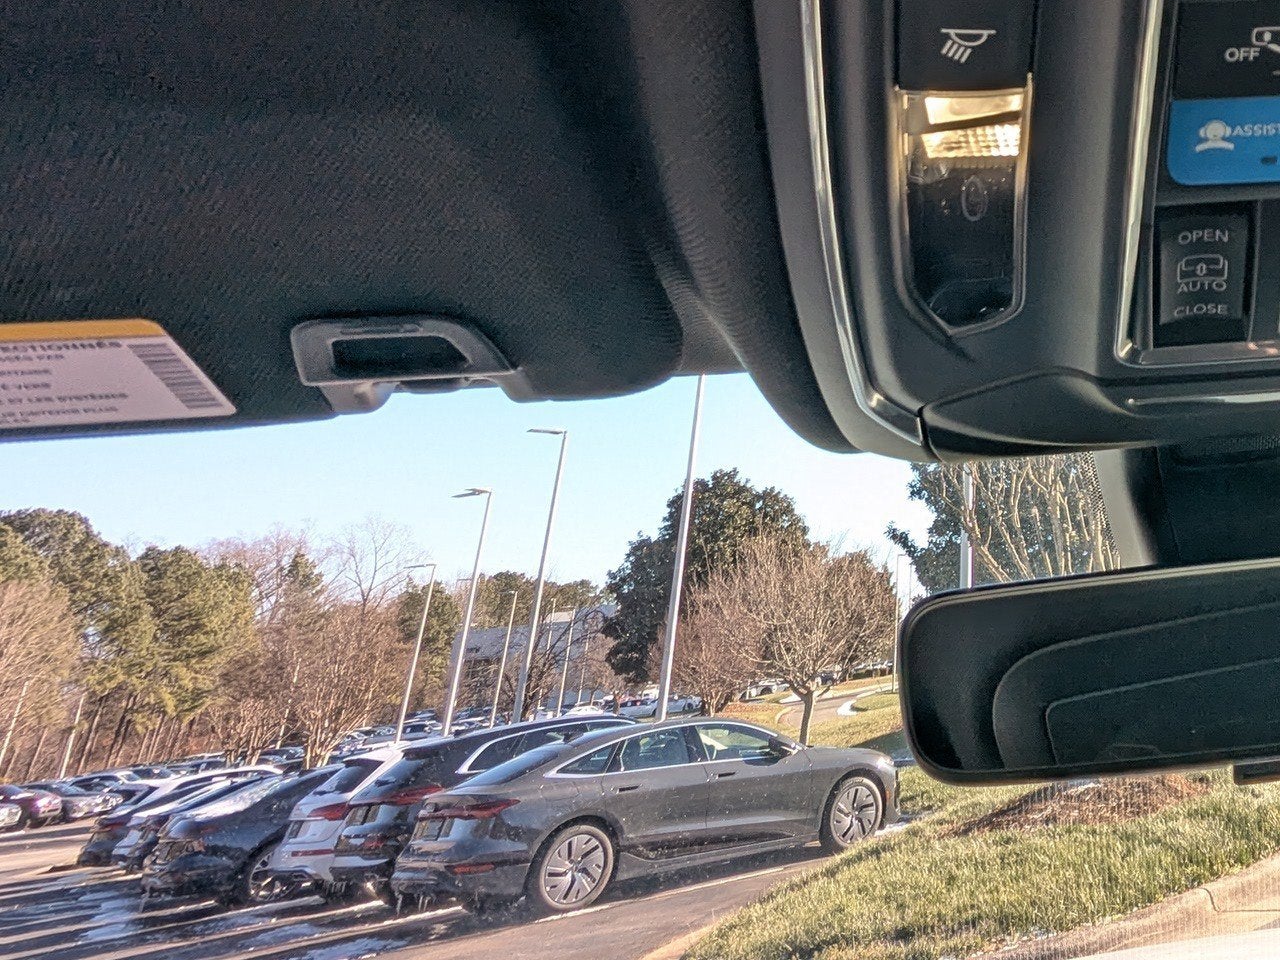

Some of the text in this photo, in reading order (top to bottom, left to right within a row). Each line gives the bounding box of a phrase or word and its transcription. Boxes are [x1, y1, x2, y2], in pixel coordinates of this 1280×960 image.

[1224, 47, 1261, 62] OFF
[1178, 228, 1229, 245] OPEN
[1177, 280, 1227, 294] AUTO
[1174, 302, 1228, 317] CLOSE
